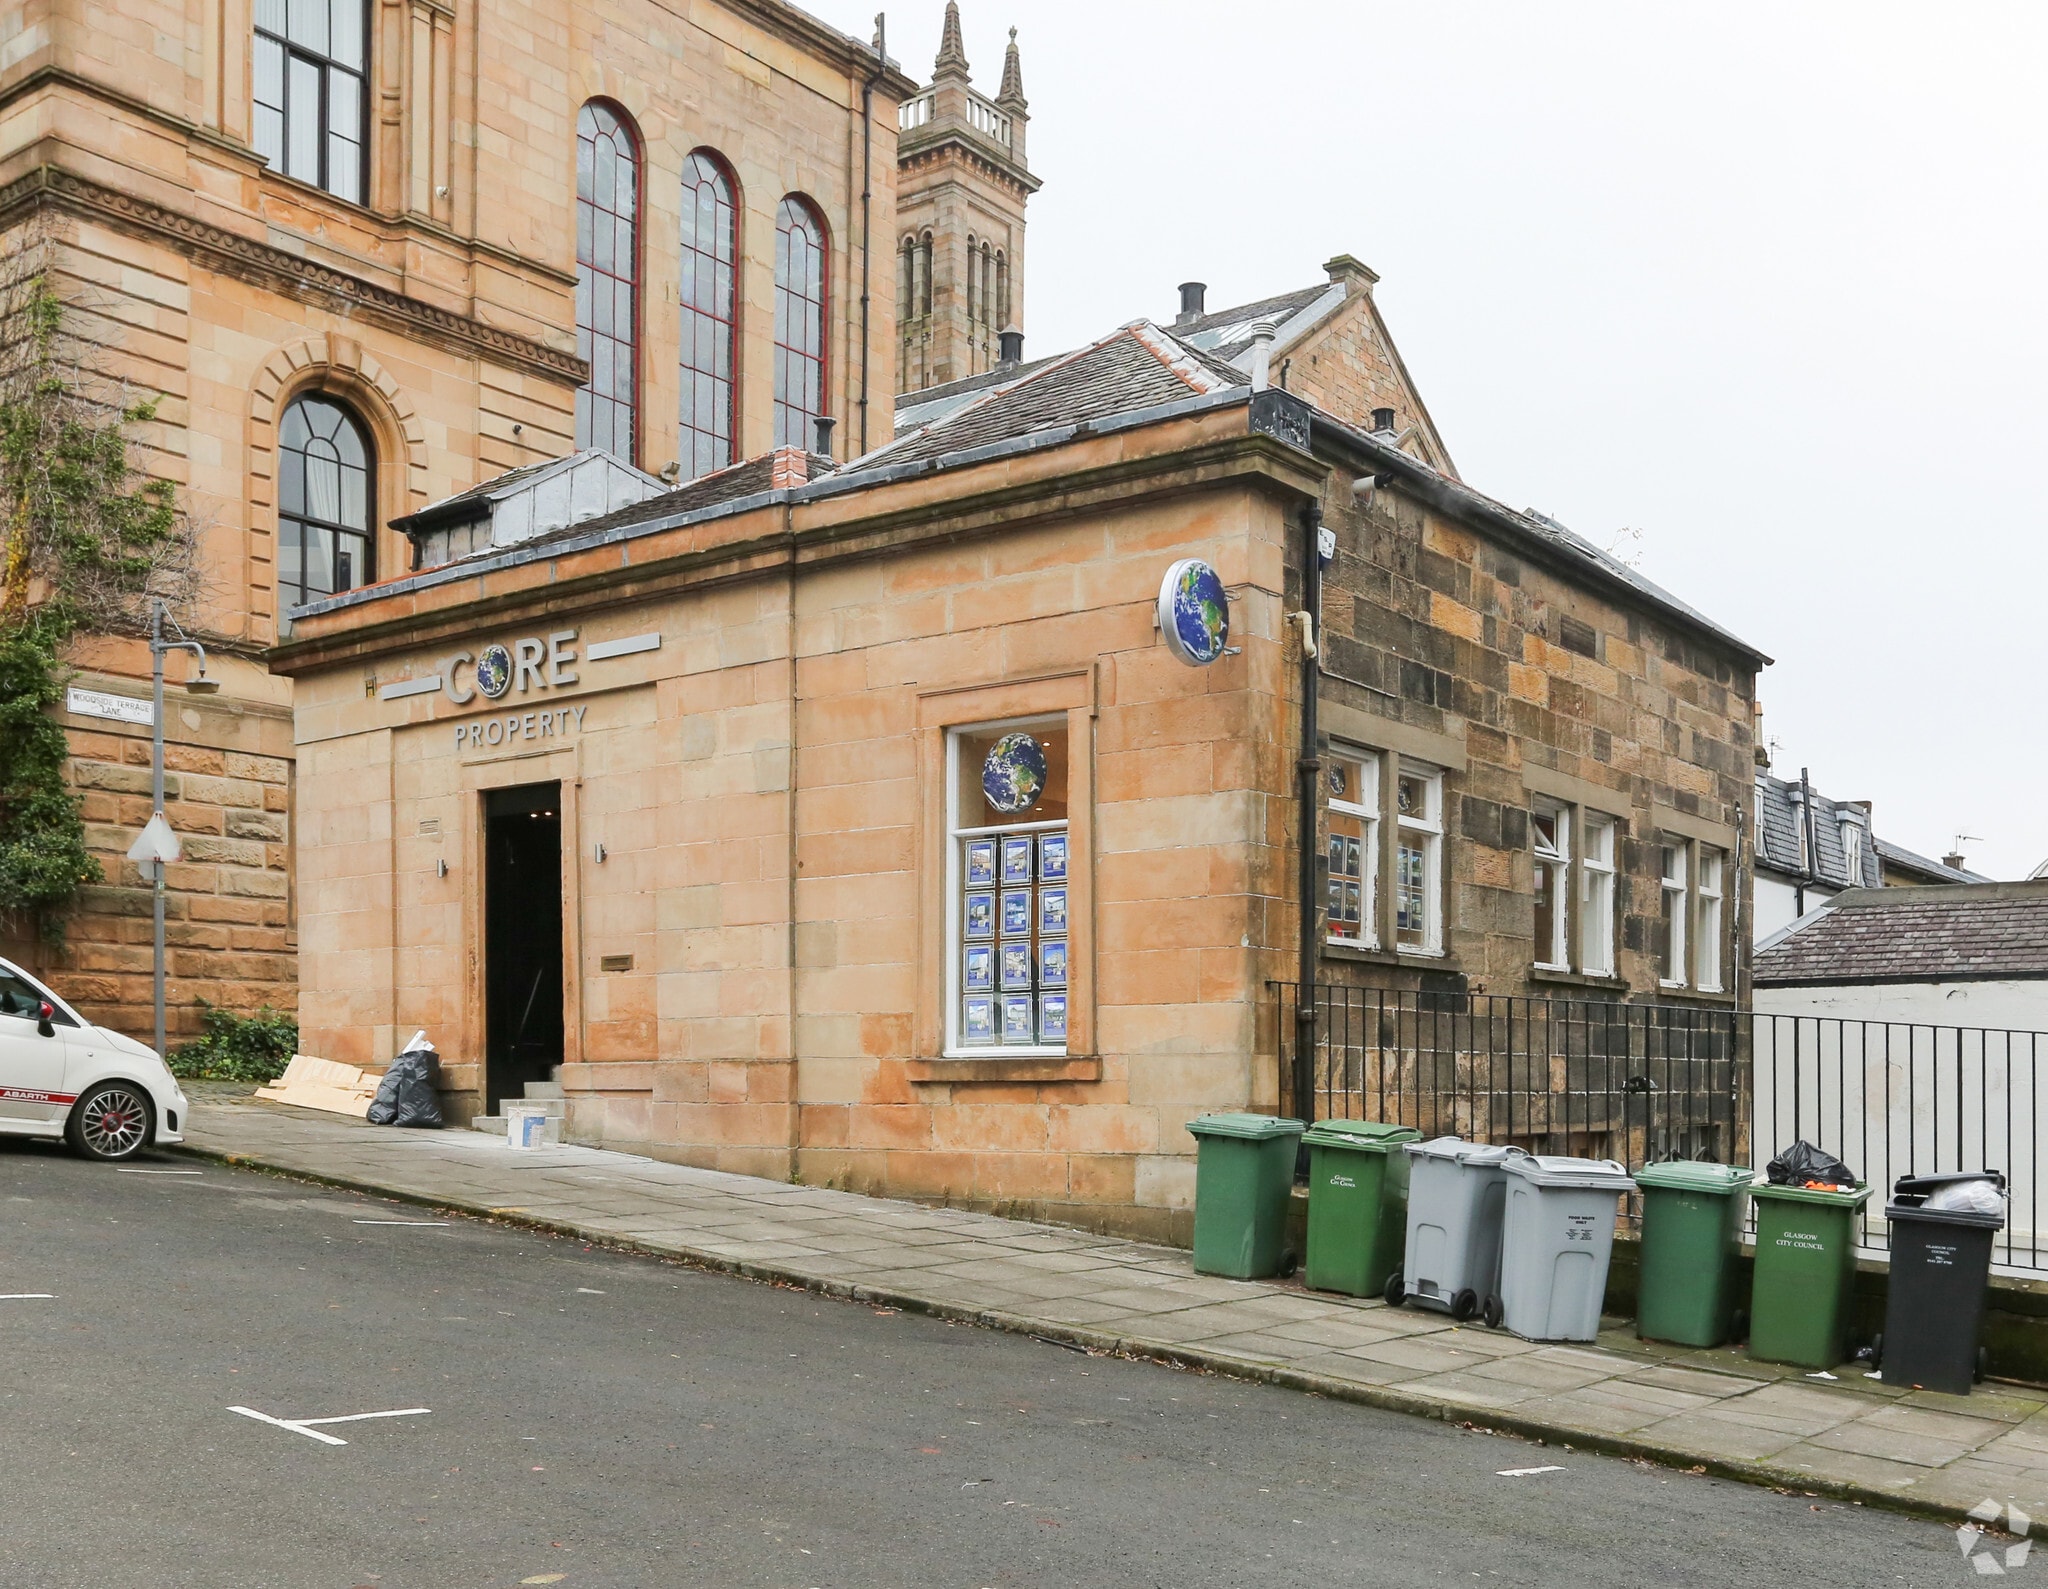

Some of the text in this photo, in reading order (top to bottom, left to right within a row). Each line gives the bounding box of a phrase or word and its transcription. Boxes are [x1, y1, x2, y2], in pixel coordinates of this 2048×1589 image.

[446, 629, 579, 703] CORE
[73, 694, 150, 713] WOODSIDE TERRACE
[100, 705, 122, 716] LANE
[454, 705, 588, 749] PROPERTY
[3, 1090, 49, 1101] ABARTH
[1784, 1231, 1818, 1240] GLASGOW
[1793, 1241, 1824, 1250] COUNCIL
